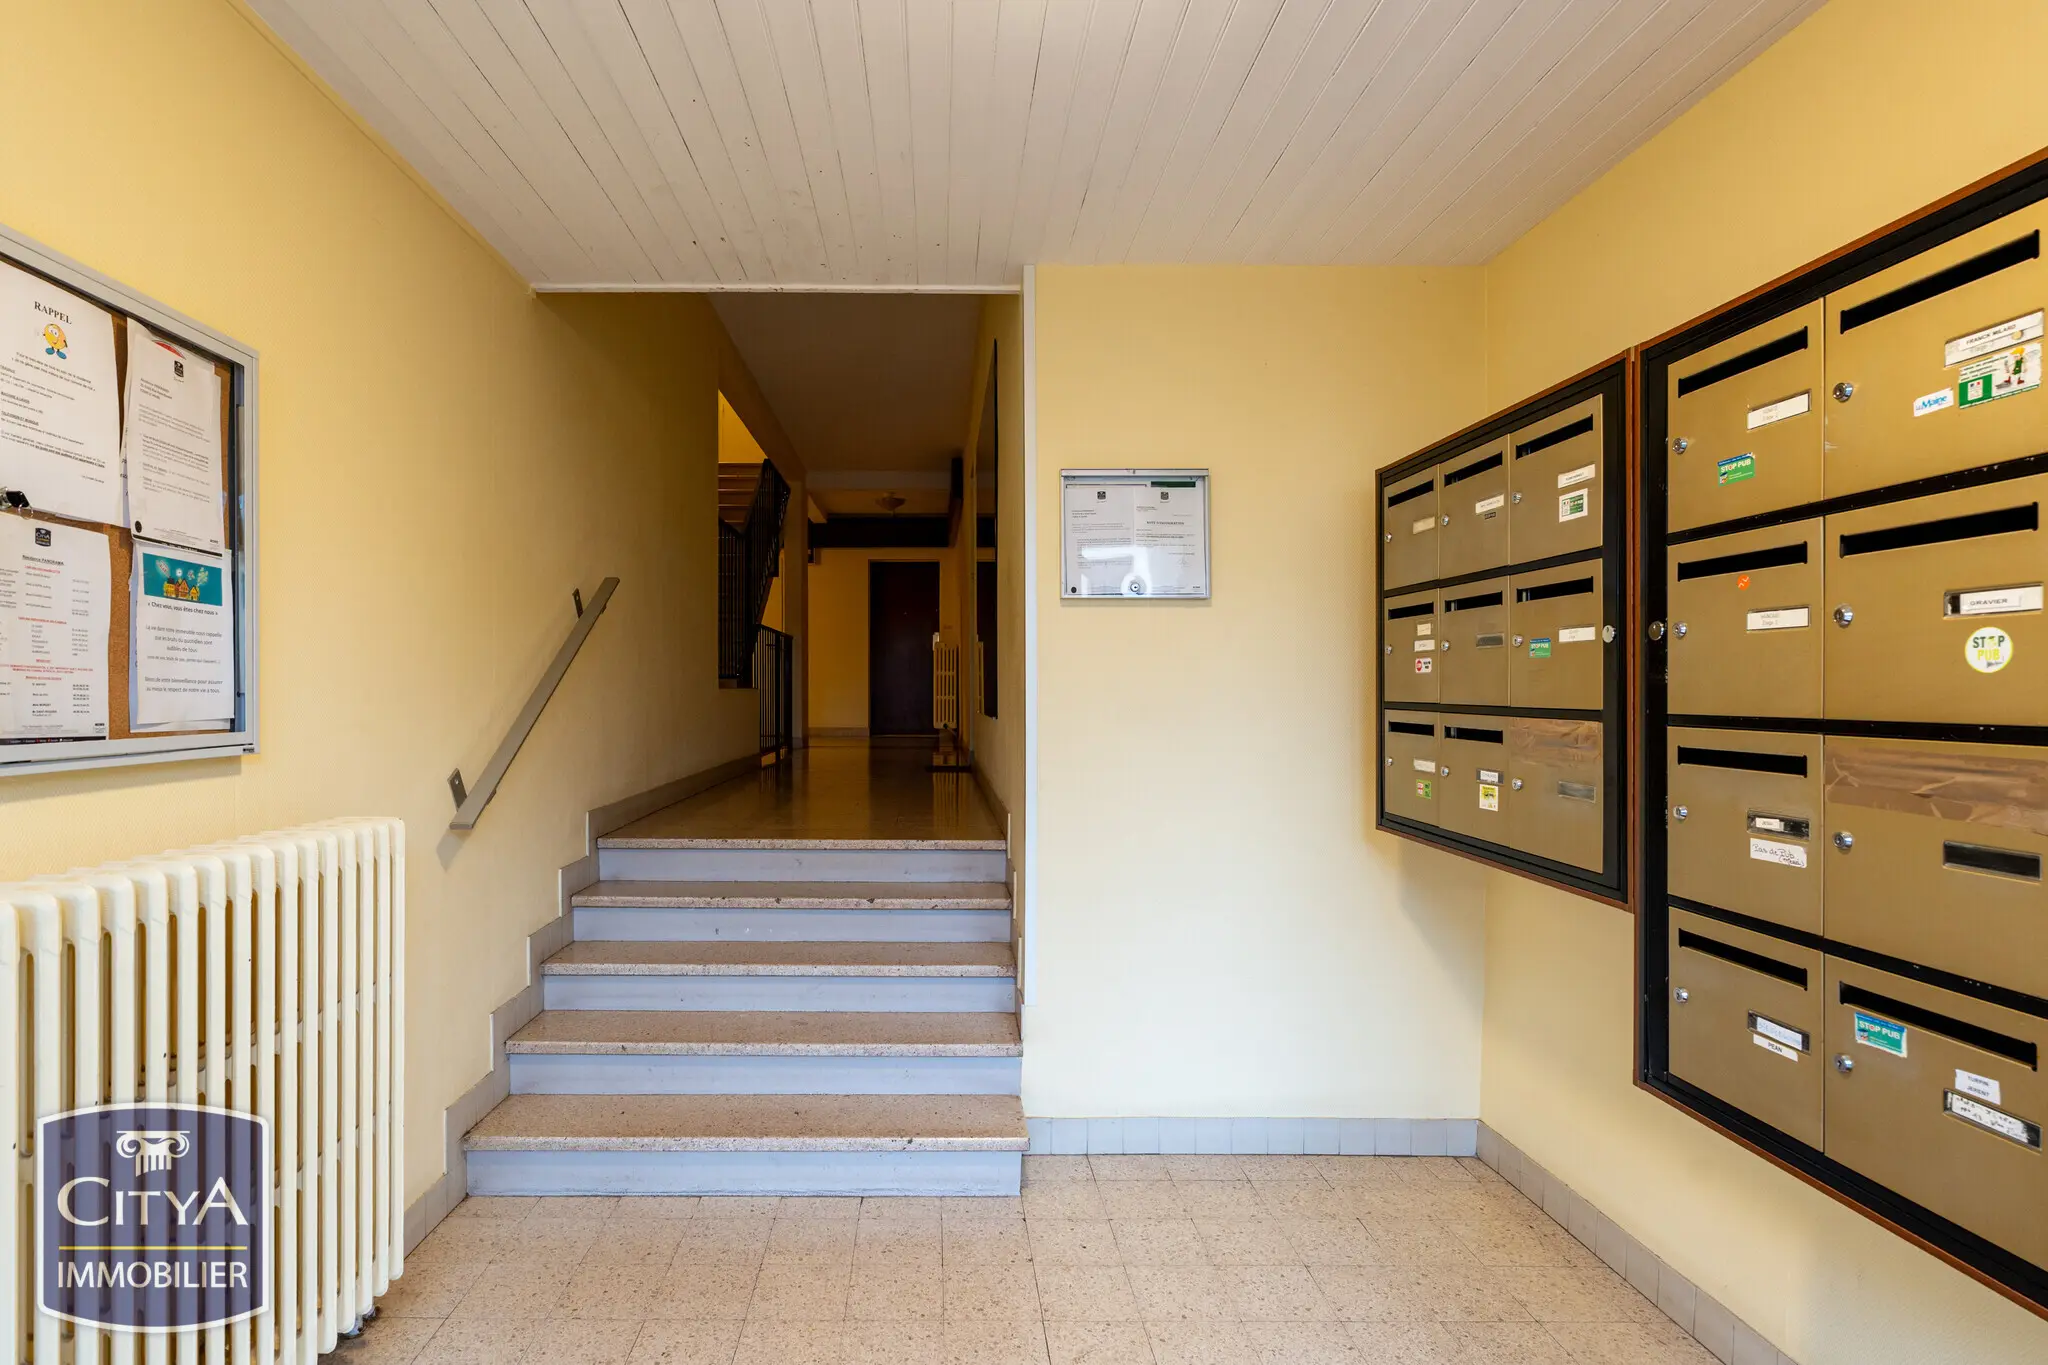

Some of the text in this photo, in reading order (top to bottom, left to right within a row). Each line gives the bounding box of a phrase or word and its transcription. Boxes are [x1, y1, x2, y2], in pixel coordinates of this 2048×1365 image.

[34, 300, 72, 325] RAPPEL
[1966, 333, 1990, 345] FRANCK
[1720, 459, 1752, 473] STOP PUB
[1970, 598, 2008, 606] GRAVIER
[1977, 648, 2000, 661] PUB
[1859, 1021, 1900, 1040] STOP PUB
